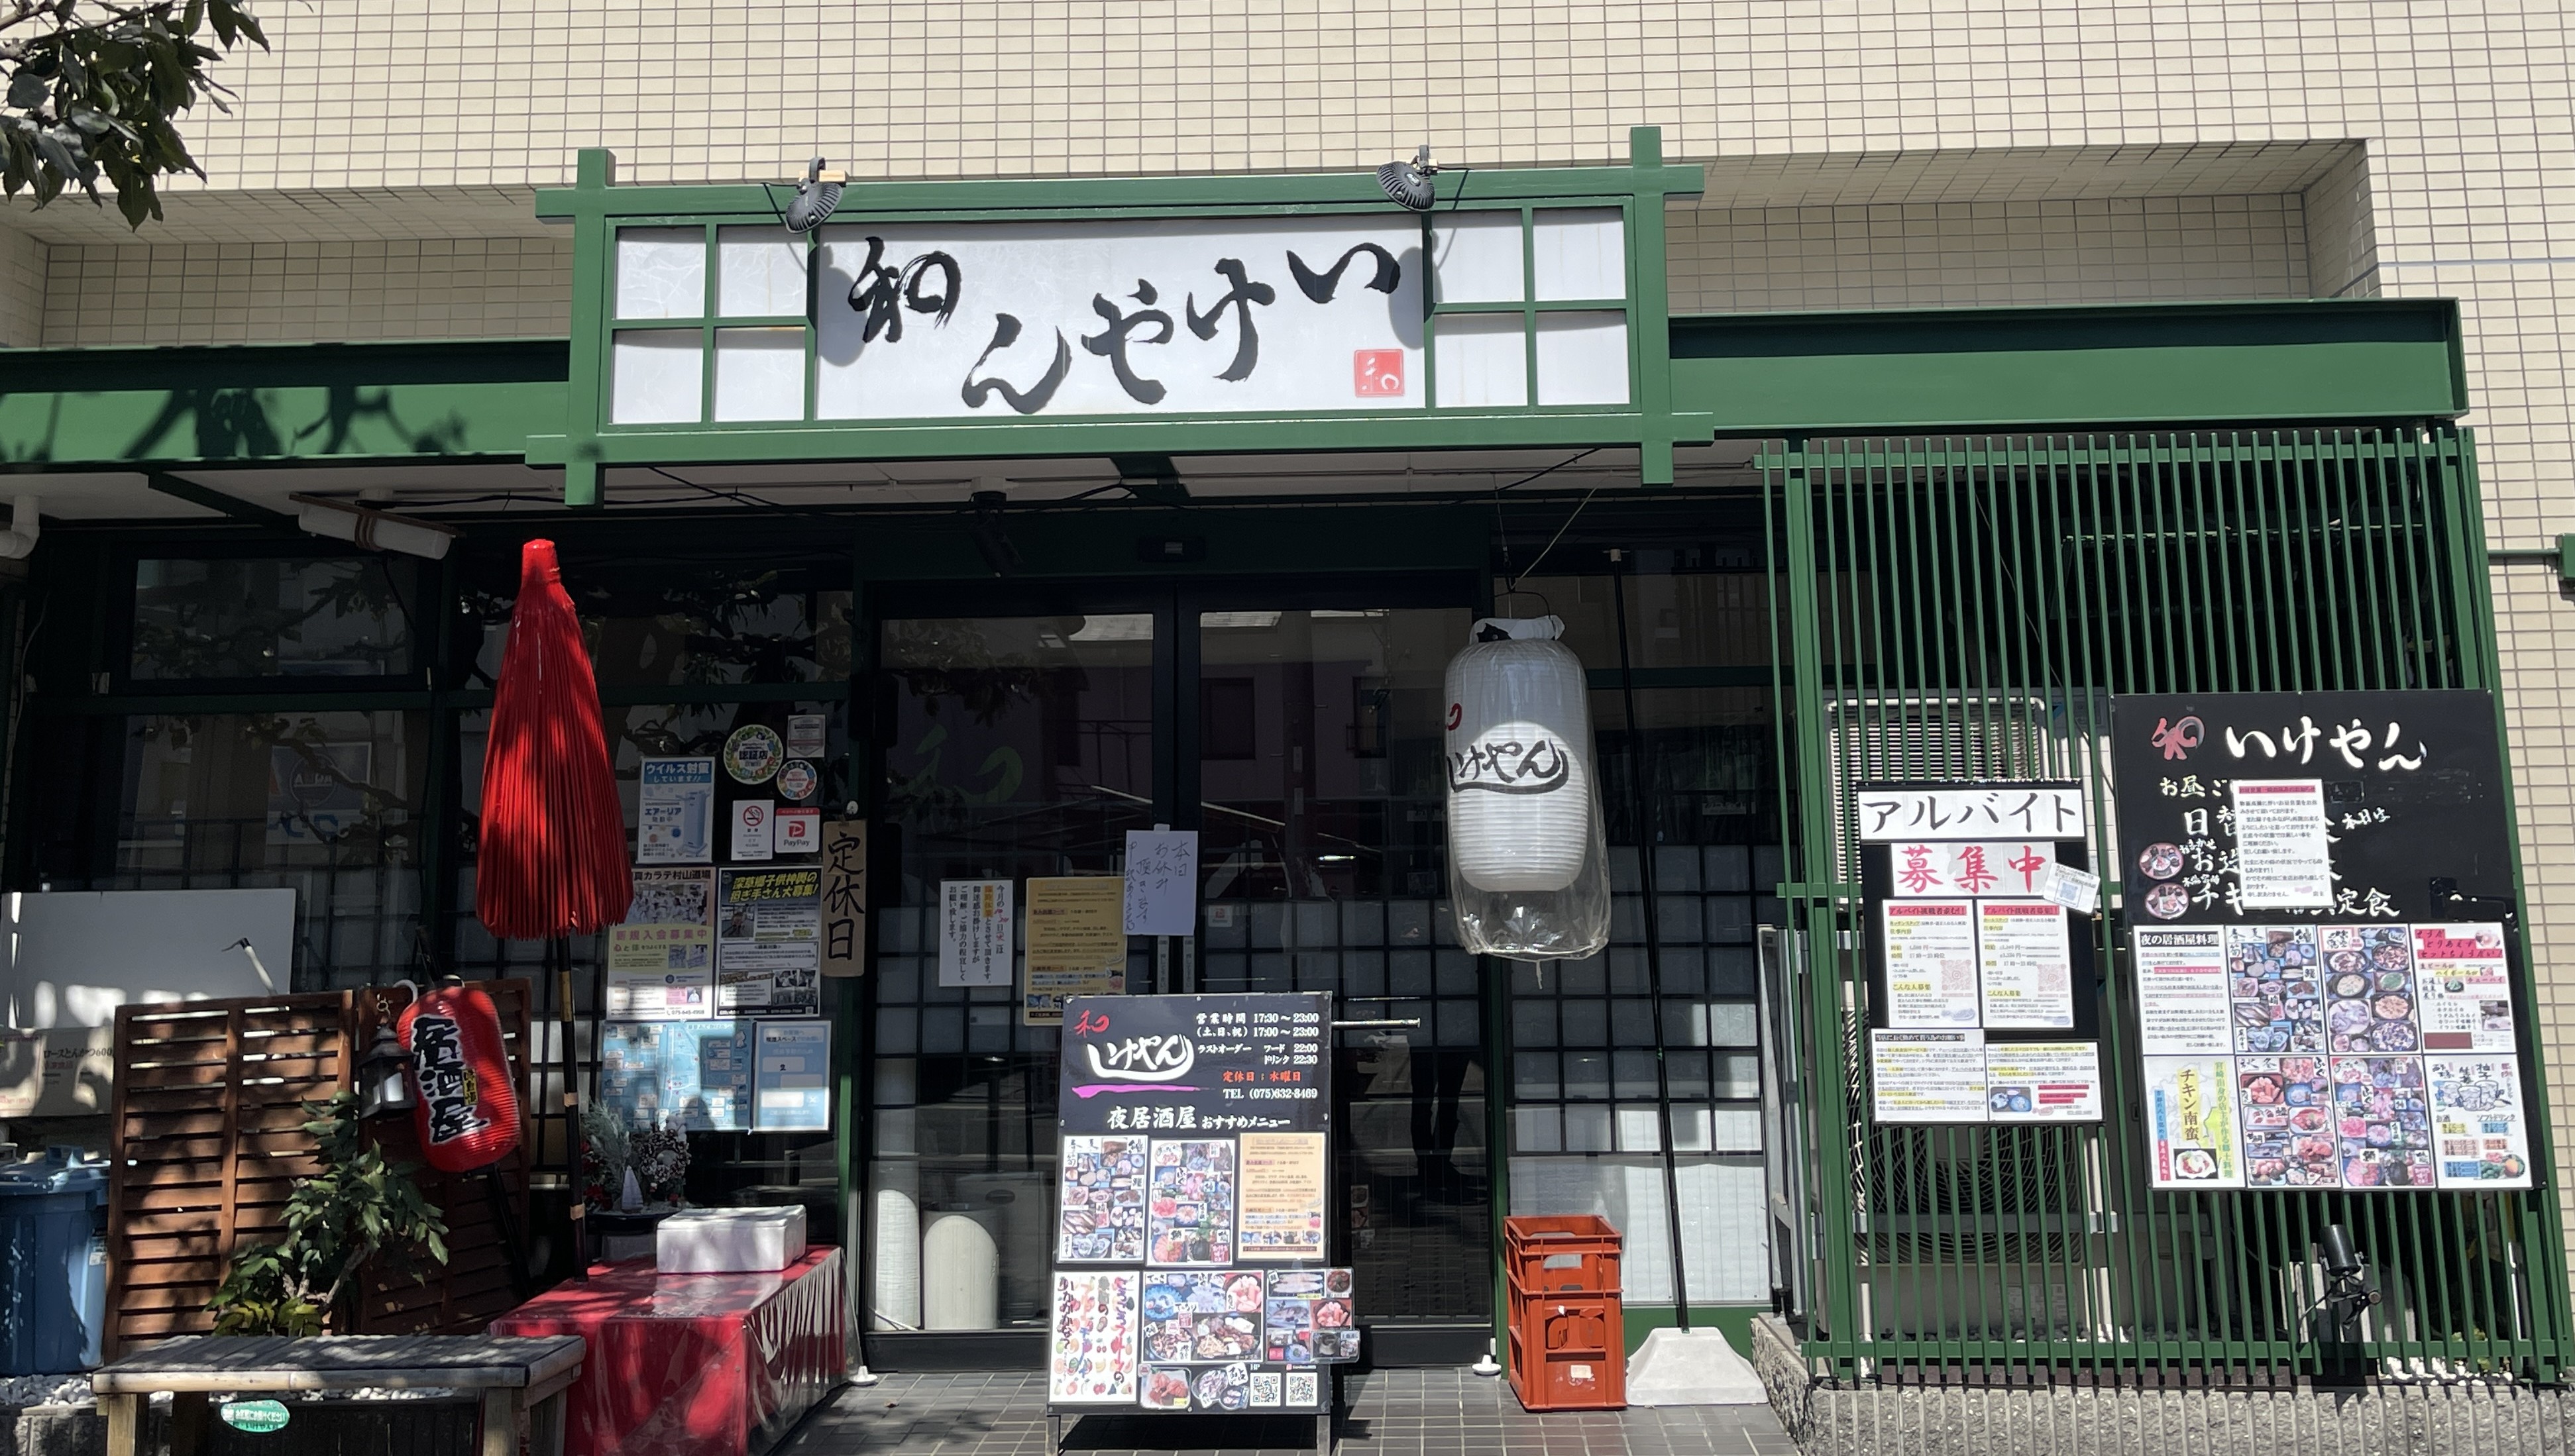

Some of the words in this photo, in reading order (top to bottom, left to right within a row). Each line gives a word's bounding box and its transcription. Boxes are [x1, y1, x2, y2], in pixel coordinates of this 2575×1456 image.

[2226, 716, 2428, 770] いけやん
[1862, 792, 2075, 833] アルバイト
[1172, 840, 1190, 878] 本日
[1897, 845, 2046, 894] 募集中
[823, 831, 865, 960] 定休日
[616, 929, 706, 941] 新規入会募集中
[2142, 934, 2219, 945] 夜の居酒屋料理
[1073, 1009, 1110, 1038] 和
[1196, 1013, 1246, 1024] 営業時間
[1254, 1013, 1278, 1023] 17:30
[1293, 1013, 1319, 1023] 23:00
[1253, 1027, 1278, 1037] 17:00
[1293, 1027, 1319, 1037] 23:00
[1197, 1043, 1252, 1054] ラストオーダー
[1264, 1043, 1286, 1053] フード
[1293, 1043, 1318, 1053] 22:00
[1264, 1055, 1289, 1065] ドリンク
[1293, 1055, 1318, 1064] 22:30
[1223, 1070, 1254, 1082] 定休日
[1270, 1070, 1301, 1082] 水曜日
[1223, 1088, 1244, 1099] TEL
[2180, 1069, 2199, 1141] チキン南蛮
[1107, 1106, 1197, 1130] 夜居酒屋
[1201, 1115, 1291, 1130] おすすめメニュー
